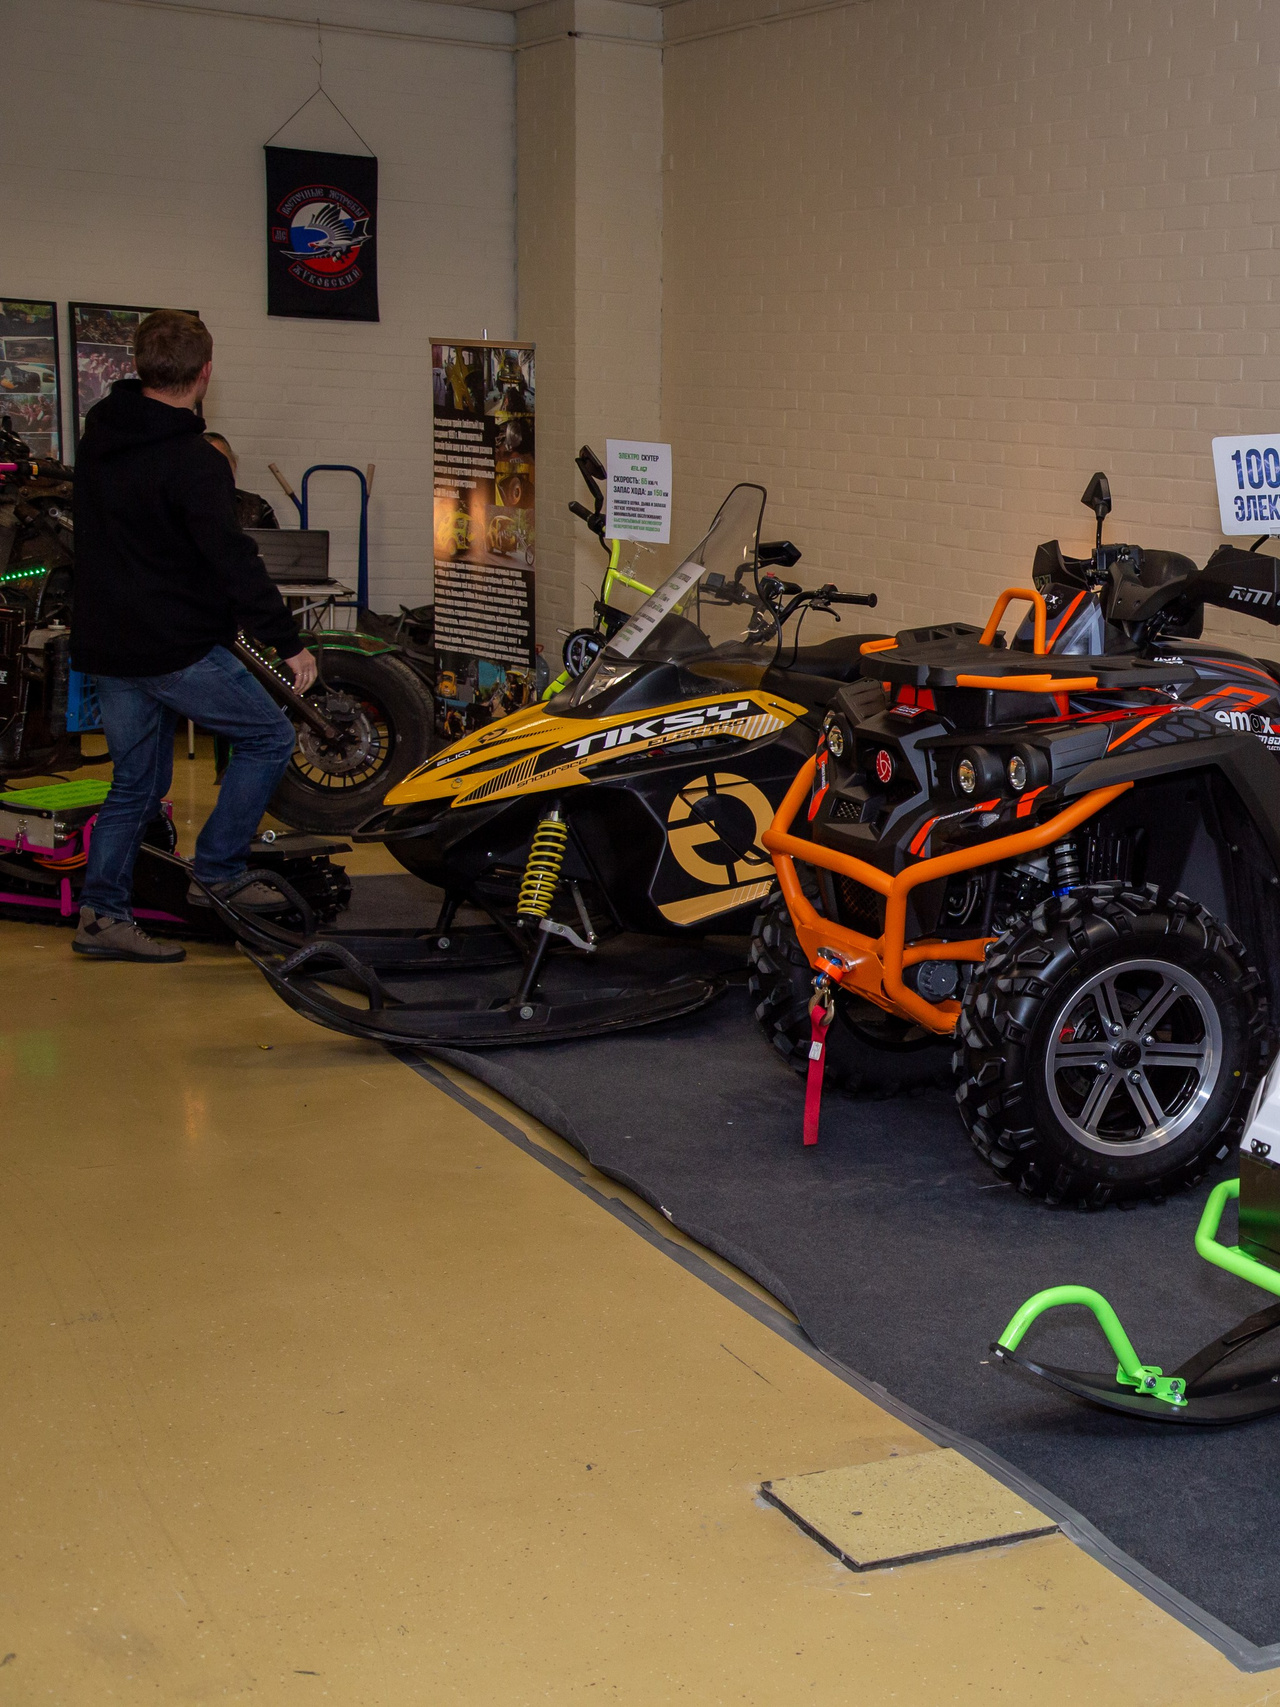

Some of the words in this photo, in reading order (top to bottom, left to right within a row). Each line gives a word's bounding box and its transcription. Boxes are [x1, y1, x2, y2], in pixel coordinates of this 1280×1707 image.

[292, 264, 360, 288] ЖУКОВСКИЙ
[618, 452, 639, 460] ЭЛЕКТРО
[641, 454, 659, 462] СКУТЕР
[613, 475, 640, 484] СКОРОСТЬ:
[613, 486, 630, 494] ЗАПАС
[631, 487, 646, 495] ХОДА:
[653, 489, 663, 497] 150
[1228, 585, 1273, 605] RM
[562, 700, 750, 759] TIKSY
[647, 718, 748, 747] ELECTRO
[1214, 710, 1275, 735] emax
